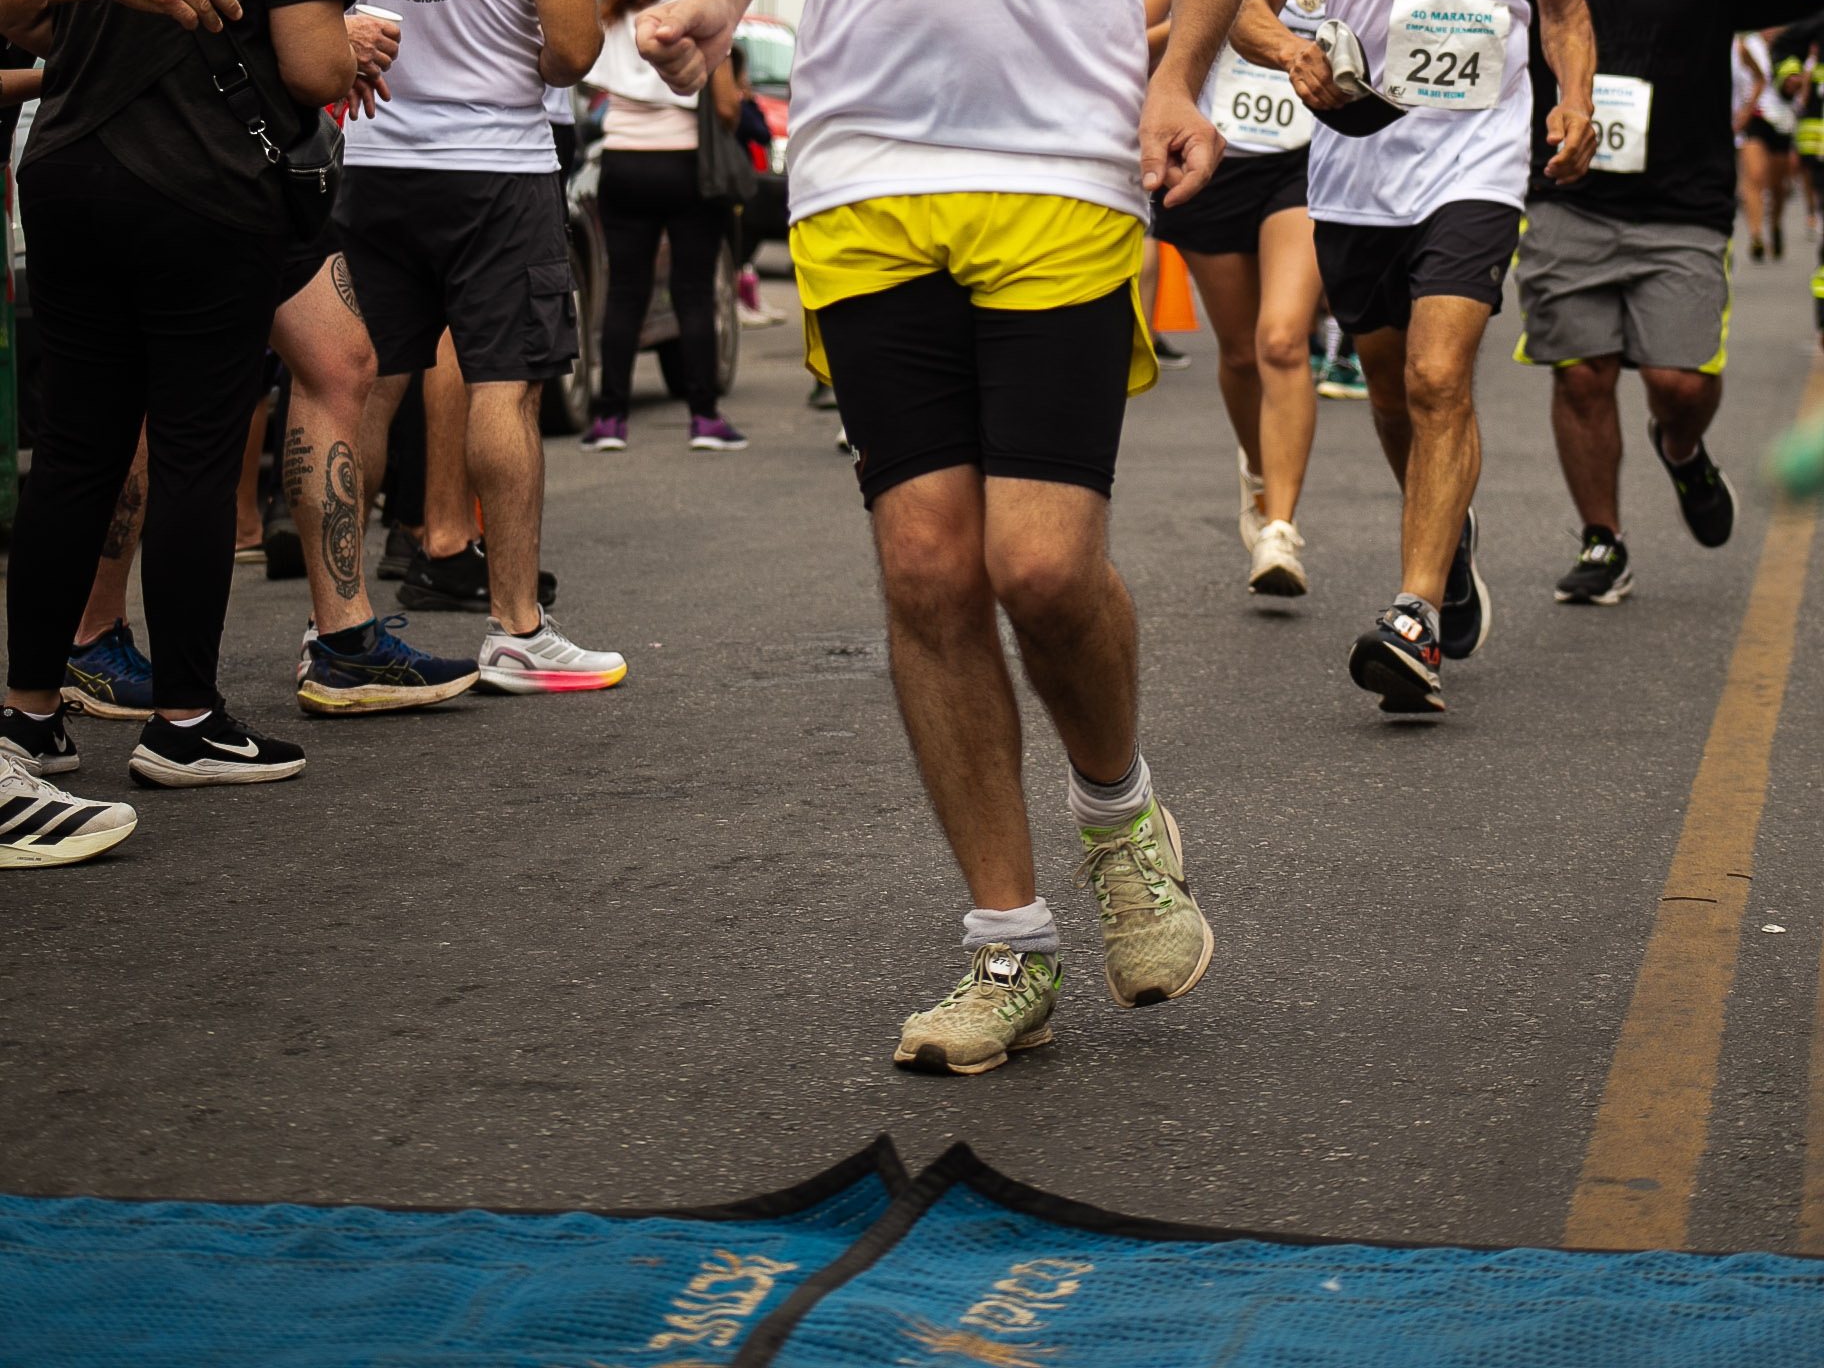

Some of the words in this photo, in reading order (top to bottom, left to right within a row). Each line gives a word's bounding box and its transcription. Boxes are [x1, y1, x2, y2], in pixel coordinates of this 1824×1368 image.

[1405, 23, 1447, 34] EMPALME
[1410, 10, 1426, 21] 40
[1430, 11, 1492, 23] MARATON
[1406, 48, 1481, 87] 224
[1232, 91, 1294, 127] 690
